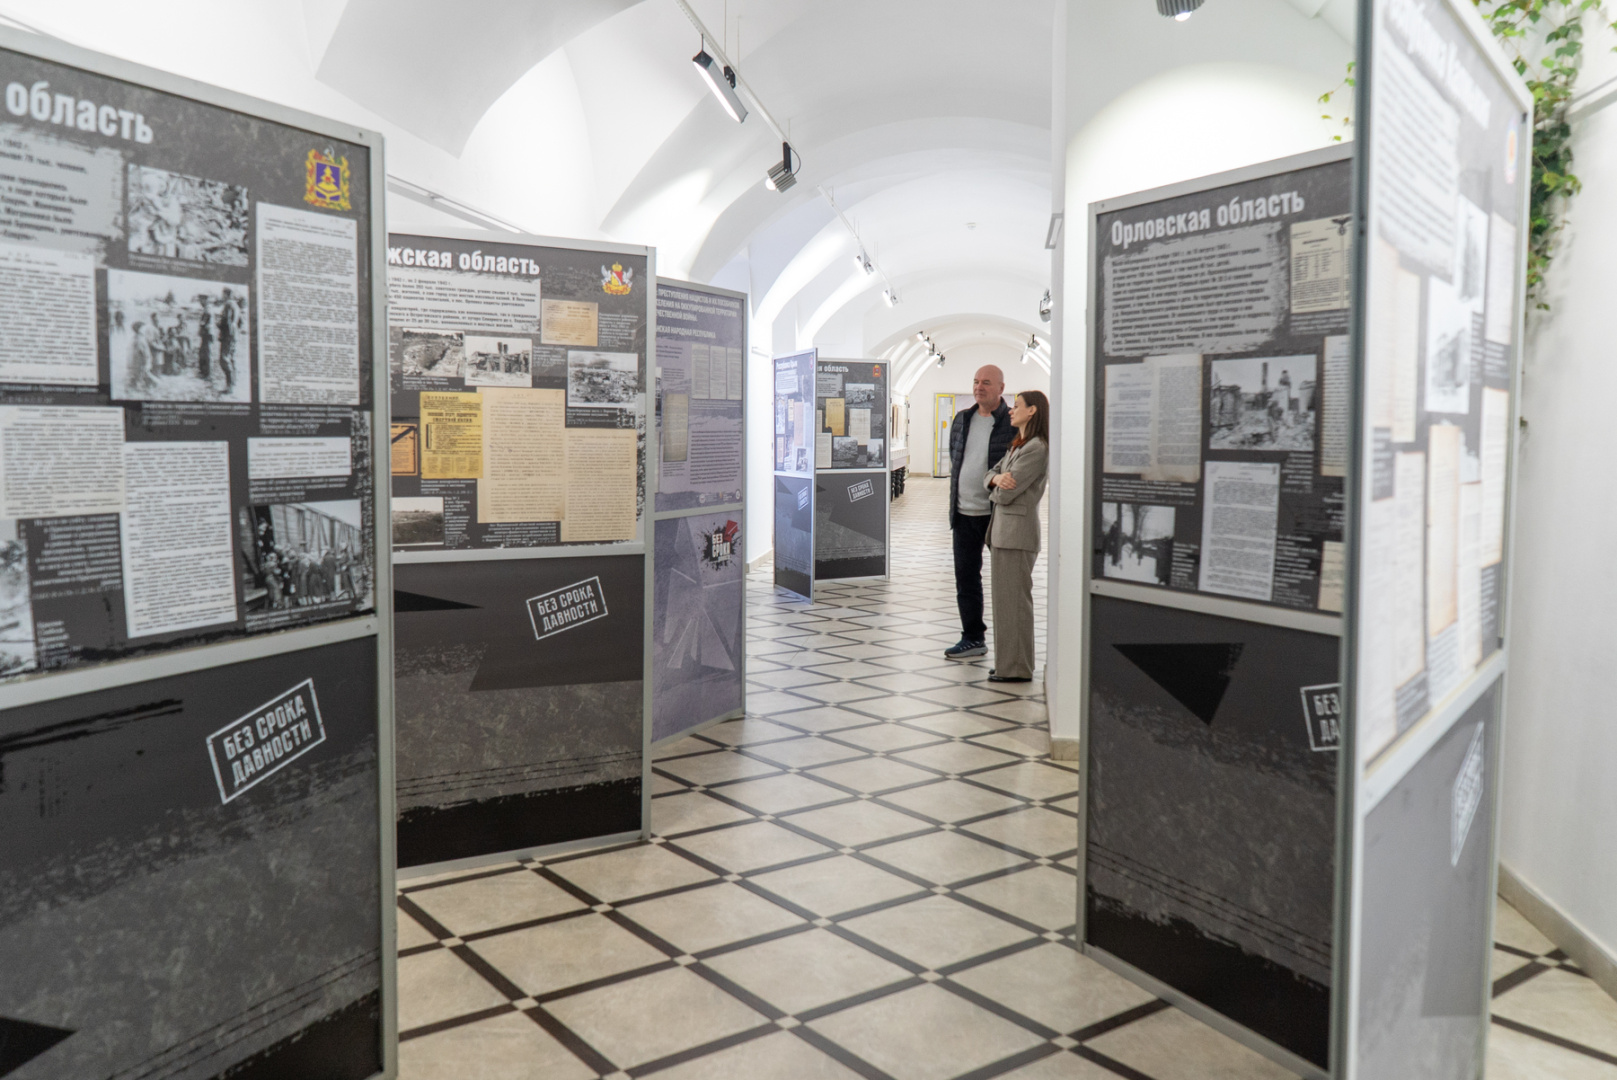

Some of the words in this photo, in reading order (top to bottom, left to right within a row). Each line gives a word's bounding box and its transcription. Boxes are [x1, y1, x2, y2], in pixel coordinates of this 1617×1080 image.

[6, 81, 154, 144] область
[1111, 208, 1210, 250] Орловская
[1216, 190, 1305, 227] область
[388, 247, 452, 268] жская
[459, 250, 540, 275] область
[824, 364, 849, 373] область
[712, 533, 723, 545] БЕЗ
[537, 597, 558, 616] БЕЗ
[559, 585, 594, 608] СРОКА
[542, 599, 598, 632] ДАВНОСТИ
[1313, 692, 1340, 716] БЕЗ
[223, 725, 255, 760] БЕЗ
[256, 694, 307, 740] СРОКА
[231, 718, 312, 788] ДАВНОСТИ
